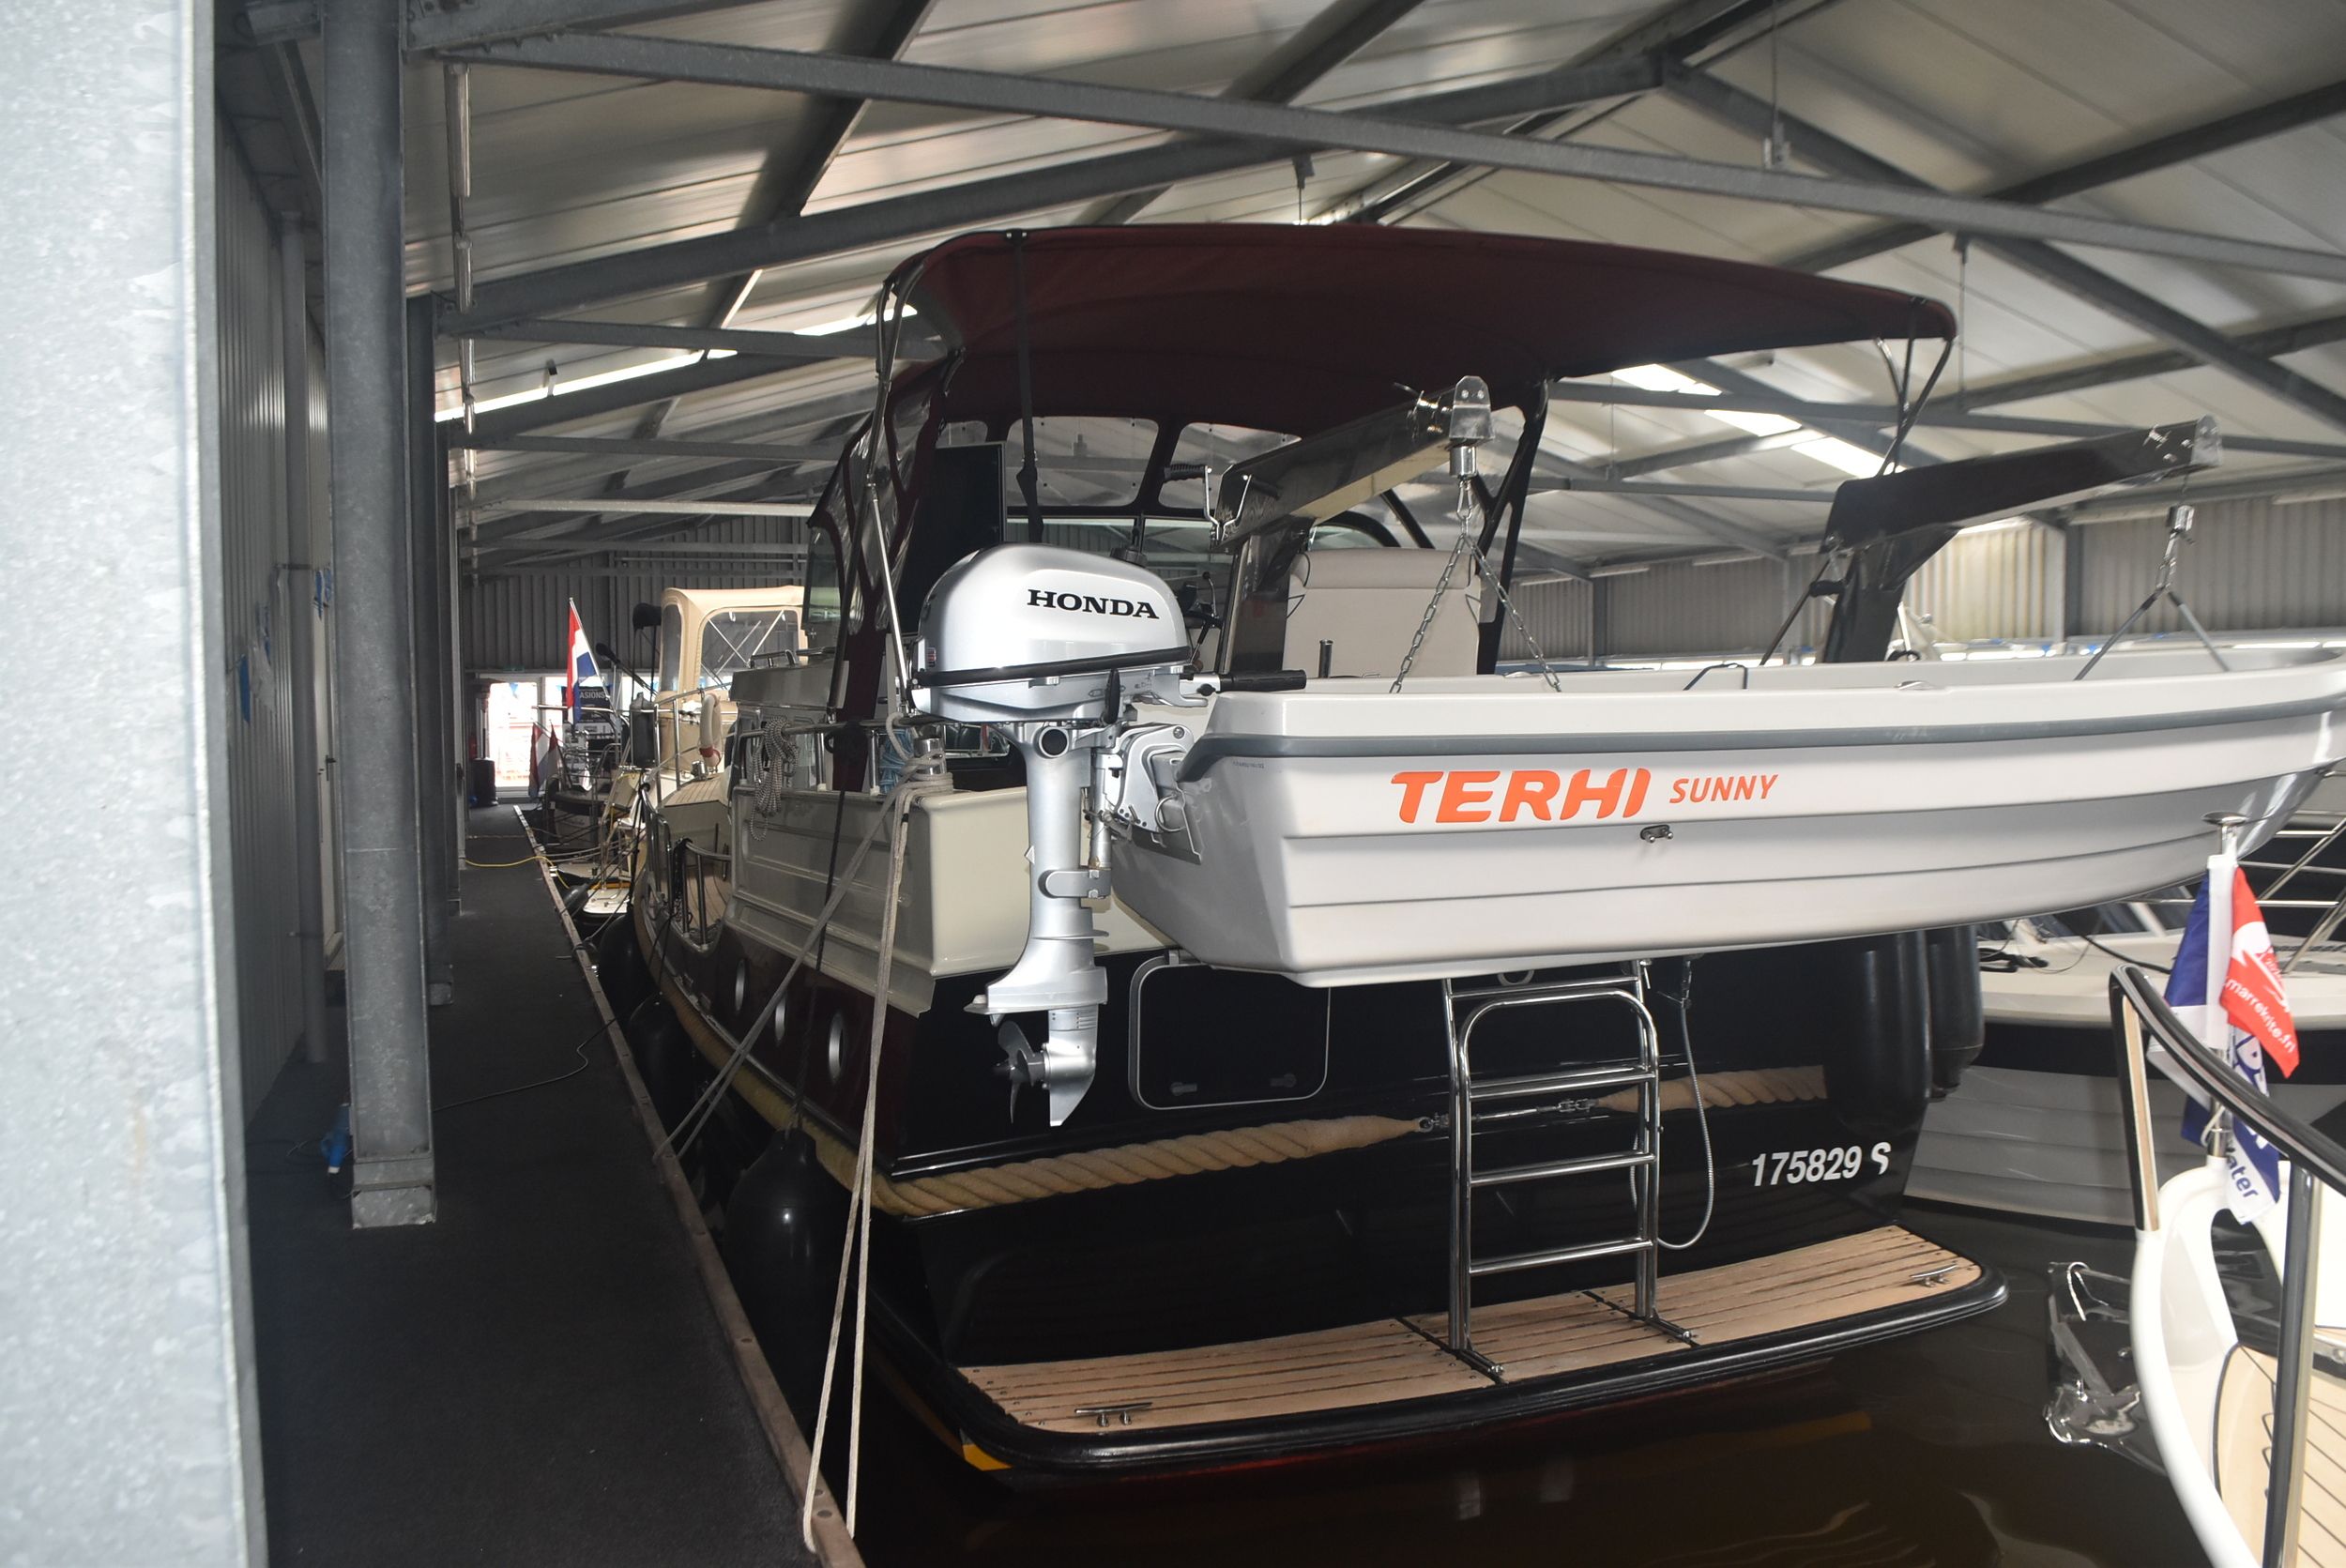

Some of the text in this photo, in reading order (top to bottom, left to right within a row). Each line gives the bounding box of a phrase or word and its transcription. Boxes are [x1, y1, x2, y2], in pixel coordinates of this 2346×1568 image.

[1028, 589, 1160, 619] HONDA
[577, 691, 606, 700] ASIONS
[1391, 768, 1778, 823] TERHI SUNNY
[1752, 1146, 1863, 1187] 175829
